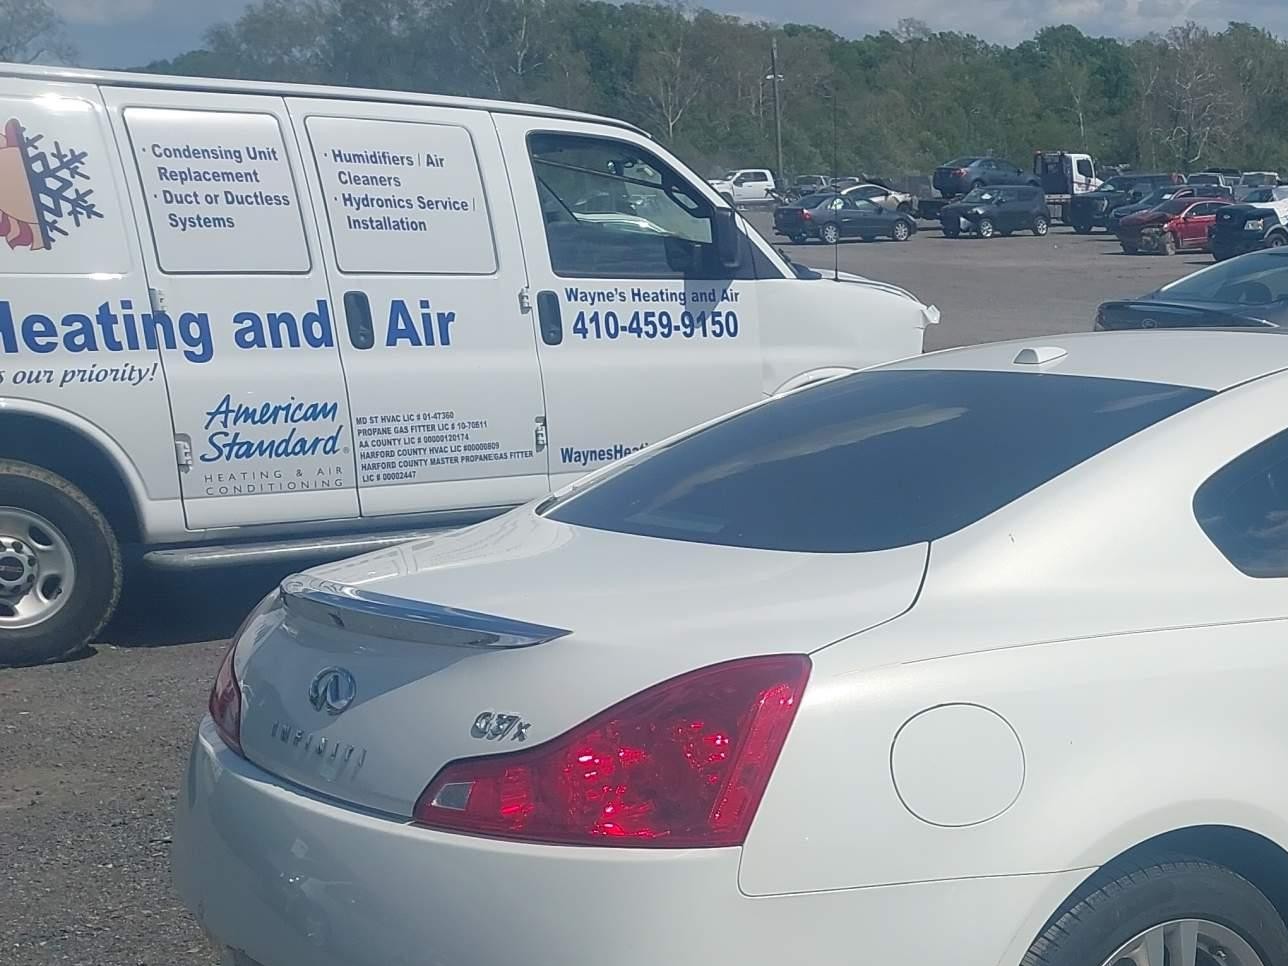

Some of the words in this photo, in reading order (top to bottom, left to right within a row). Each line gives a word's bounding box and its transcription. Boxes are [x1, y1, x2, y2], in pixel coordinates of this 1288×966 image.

[152, 143, 244, 164] Condensing
[246, 146, 279, 161] Unit
[331, 149, 415, 167] Humidifiers
[426, 153, 446, 168] Air
[157, 166, 261, 185] Replacement
[338, 170, 402, 187] Cleaners
[162, 189, 201, 205] Duct
[205, 194, 220, 205] or
[223, 190, 291, 206] Ductless
[341, 192, 414, 211] Hydronics
[417, 195, 469, 211] Service
[168, 212, 236, 232] Systems
[346, 215, 428, 232] Installation
[565, 287, 627, 306] Wayne's
[631, 287, 687, 306] Heating
[692, 288, 717, 303] and
[720, 288, 740, 303] Air
[232, 299, 335, 351] and
[385, 299, 458, 348] Air
[572, 310, 739, 340] 410-459-9150
[12, 367, 54, 385] our
[59, 362, 159, 388] priority!
[204, 393, 339, 430] American
[369, 416, 379, 424] ST
[381, 415, 401, 423] HVAC
[403, 414, 415, 422] LIC
[394, 425, 409, 434] GAS
[411, 424, 436, 433] FITTER
[438, 423, 450, 431] LIC
[200, 424, 344, 463] Standard
[359, 440, 370, 449] AA
[371, 438, 402, 447] COUNTY
[403, 437, 416, 445] LIC
[360, 450, 396, 460] HARFORD
[397, 447, 427, 457] COUNTY
[429, 446, 449, 455] HVAC
[450, 445, 462, 453] LIC
[361, 461, 397, 471] HARFORD
[398, 459, 428, 468] COUNTY
[430, 456, 460, 465] MASTER
[509, 450, 534, 459] FITTER
[204, 470, 283, 484] HEATING
[296, 469, 304, 478] &
[316, 466, 344, 477] AIR
[362, 474, 375, 482] LIC
[206, 479, 344, 496] CONDITIONING
[271, 719, 368, 769] INFINITI
